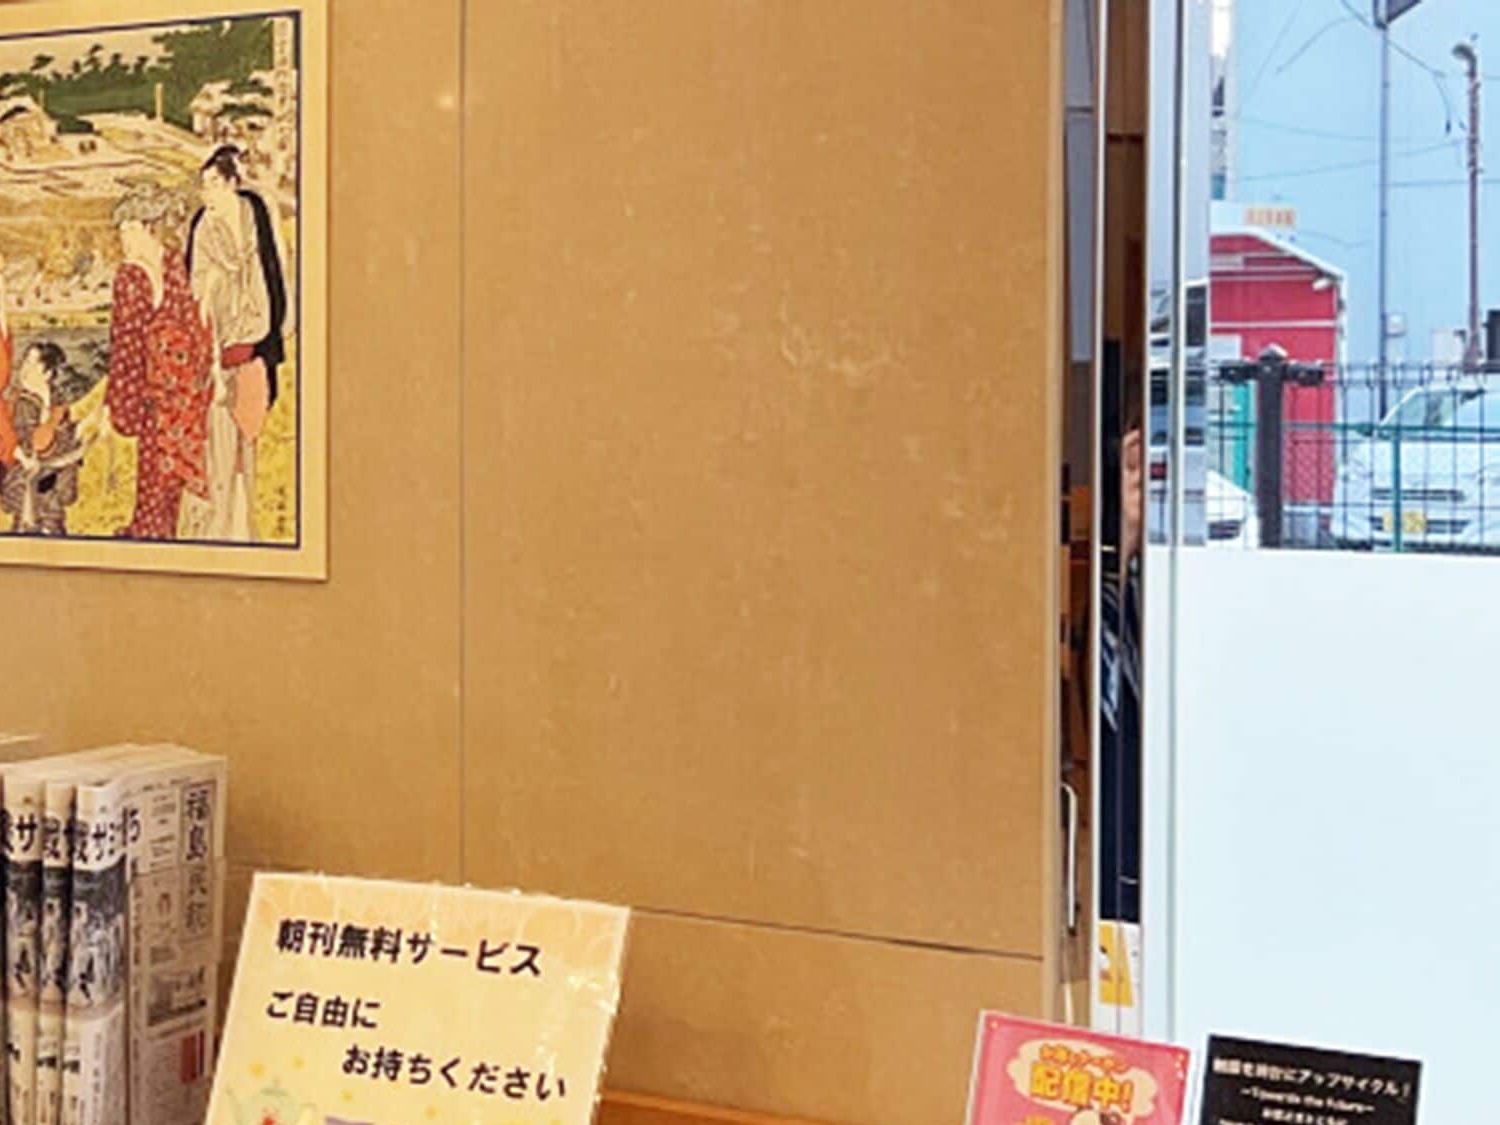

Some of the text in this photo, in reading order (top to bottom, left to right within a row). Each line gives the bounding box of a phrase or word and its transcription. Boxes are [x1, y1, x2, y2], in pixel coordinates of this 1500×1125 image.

[277, 918, 542, 976] 朝刊無料サービス
[265, 989, 383, 1029] ご自由に
[342, 1044, 566, 1101] お持ちください
